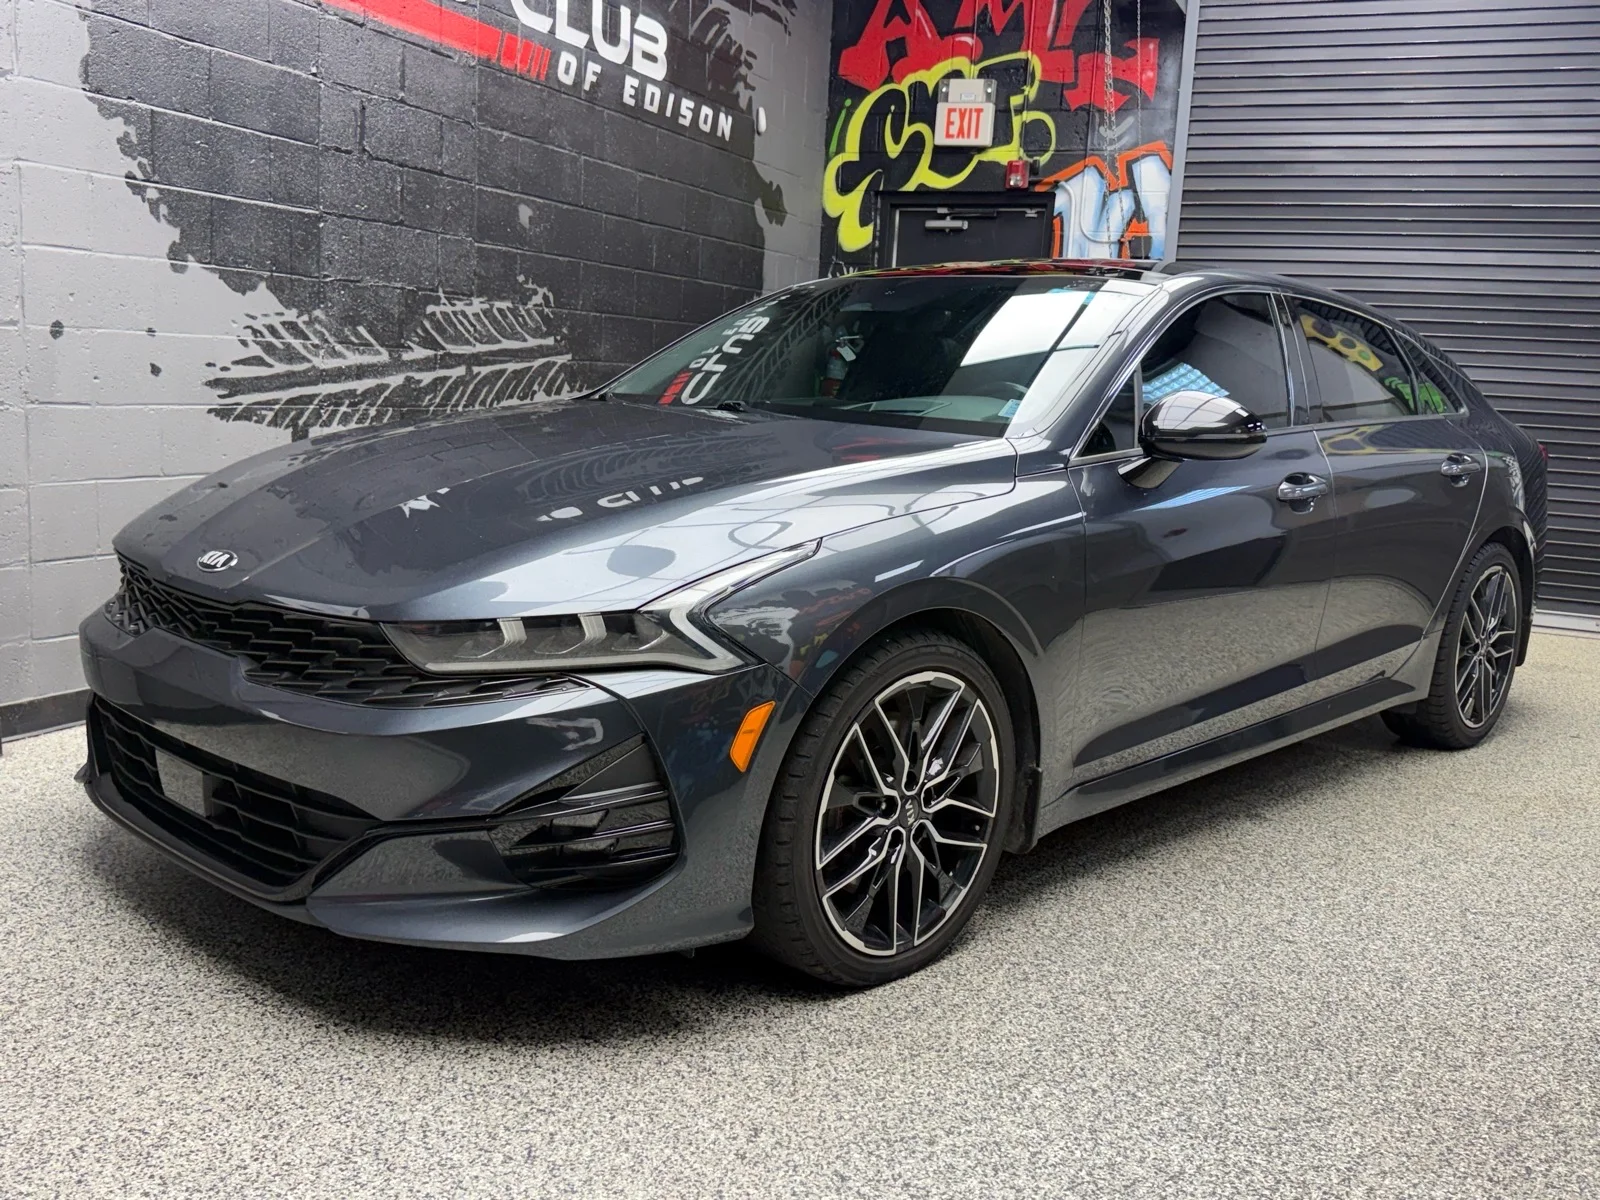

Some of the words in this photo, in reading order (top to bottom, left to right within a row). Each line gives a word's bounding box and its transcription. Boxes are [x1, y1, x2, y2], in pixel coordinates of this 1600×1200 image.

[557, 51, 602, 91] OF
[622, 74, 733, 141] EDISON
[944, 107, 984, 139] EXIT
[200, 550, 231, 568] KIA
